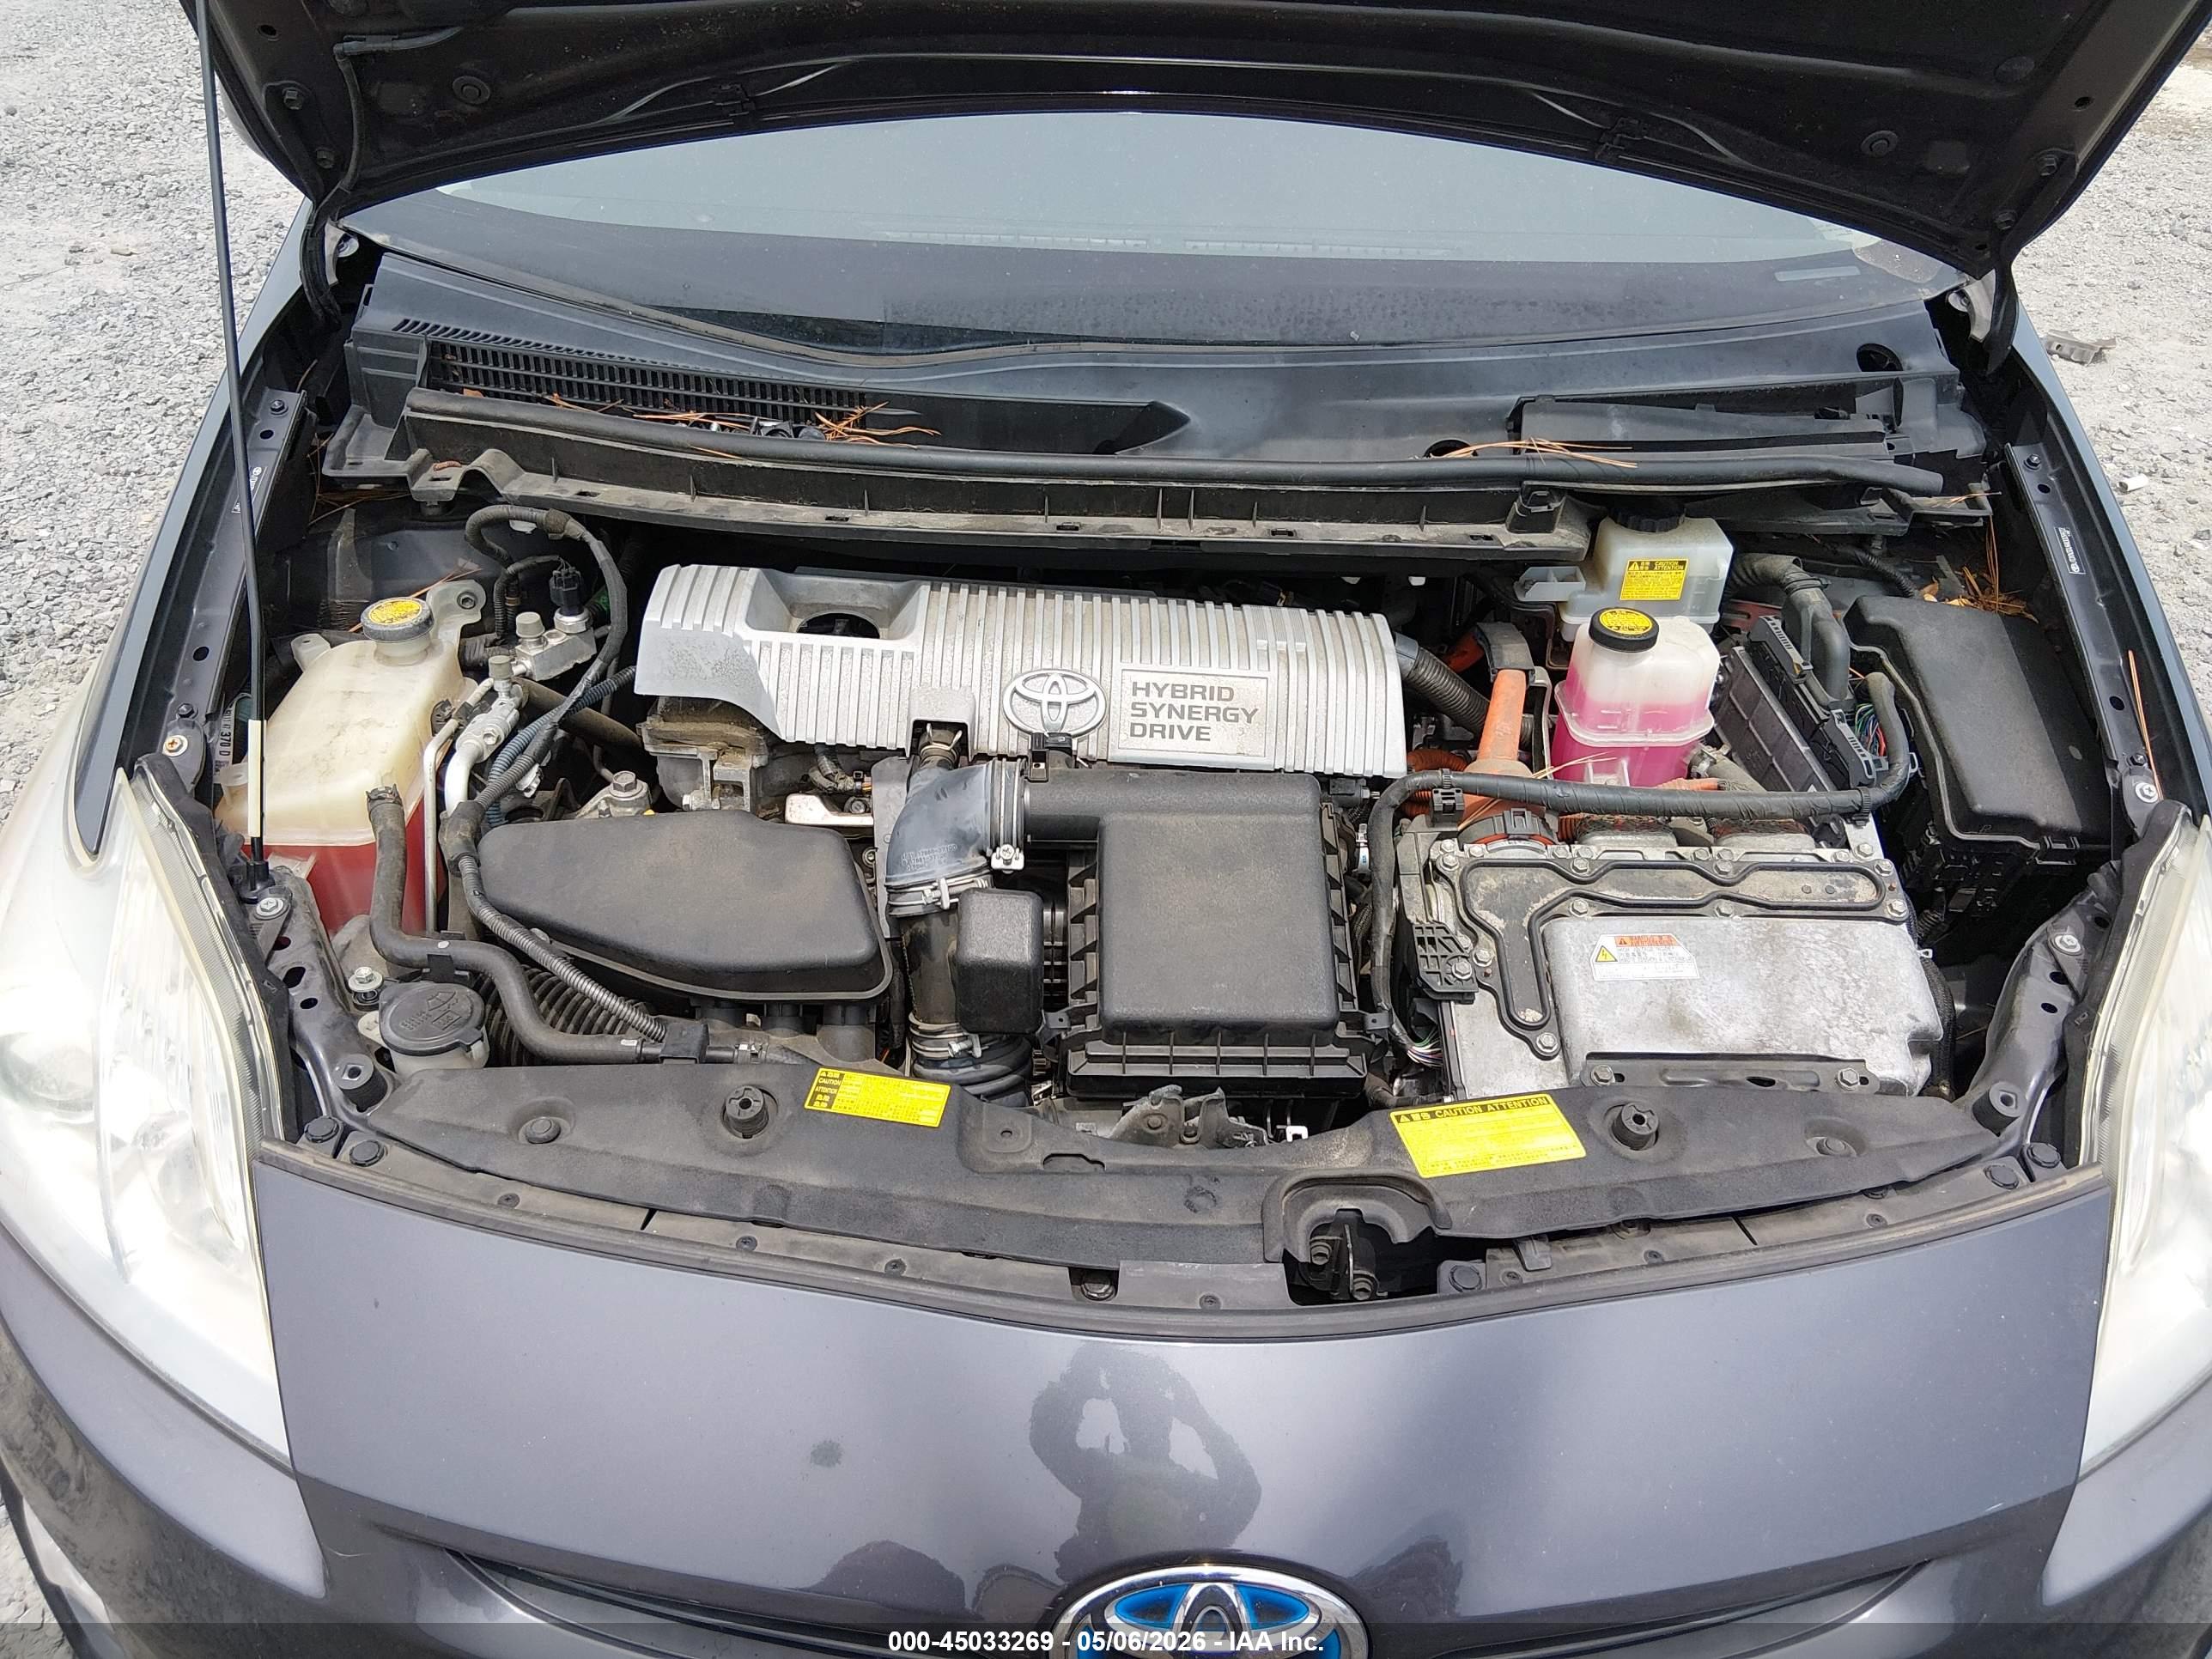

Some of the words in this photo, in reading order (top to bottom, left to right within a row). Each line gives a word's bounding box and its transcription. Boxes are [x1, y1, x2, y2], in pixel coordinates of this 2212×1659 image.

[1132, 681, 1235, 702] HYBRID
[1130, 702, 1259, 724] SYNERGY
[1129, 722, 1212, 742] DRIVE
[815, 1085, 838, 1094] ATTENTION
[818, 1077, 842, 1086] CAUTION
[1435, 1105, 1483, 1119] CAUTION
[1487, 1097, 1547, 1112] ATTENTION
